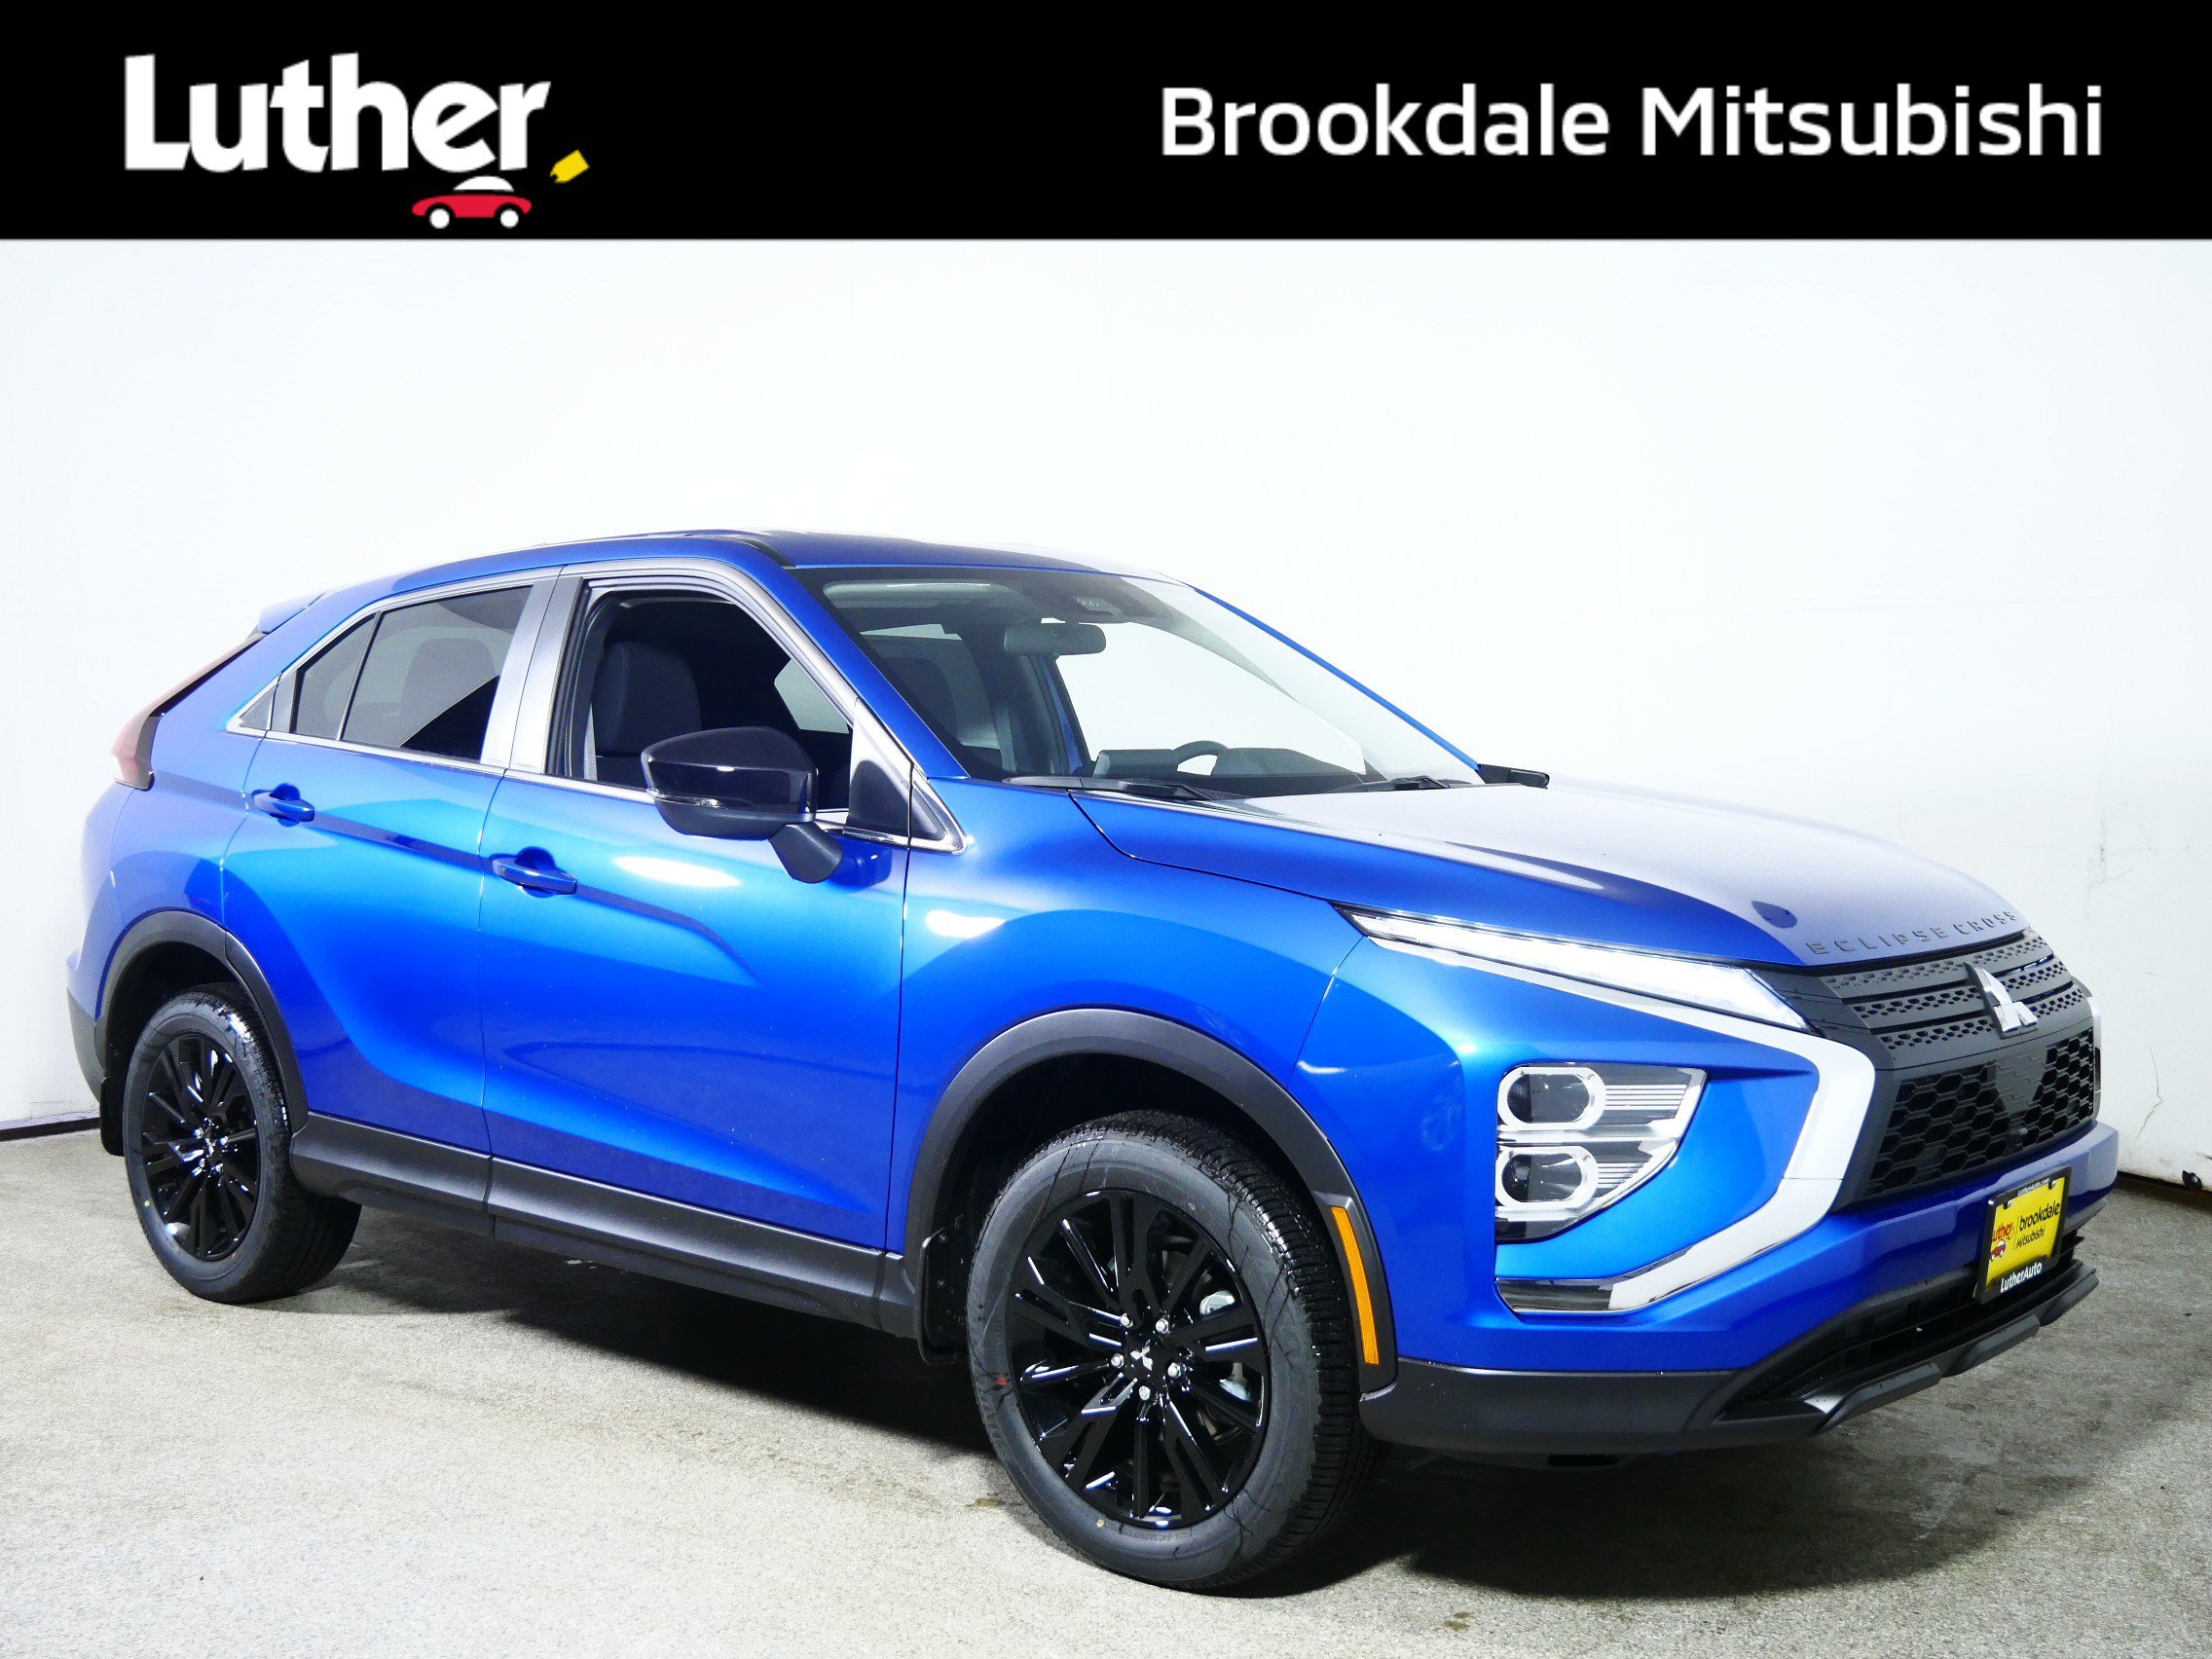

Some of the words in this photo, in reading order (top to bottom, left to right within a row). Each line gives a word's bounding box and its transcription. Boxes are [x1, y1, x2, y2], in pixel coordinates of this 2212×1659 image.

[1805, 927, 1949, 954] ECLIPSE
[1953, 910, 2017, 935] CROSS
[2019, 1201, 2060, 1232] brookdale
[2000, 1262, 2042, 1293] LutherAuto
